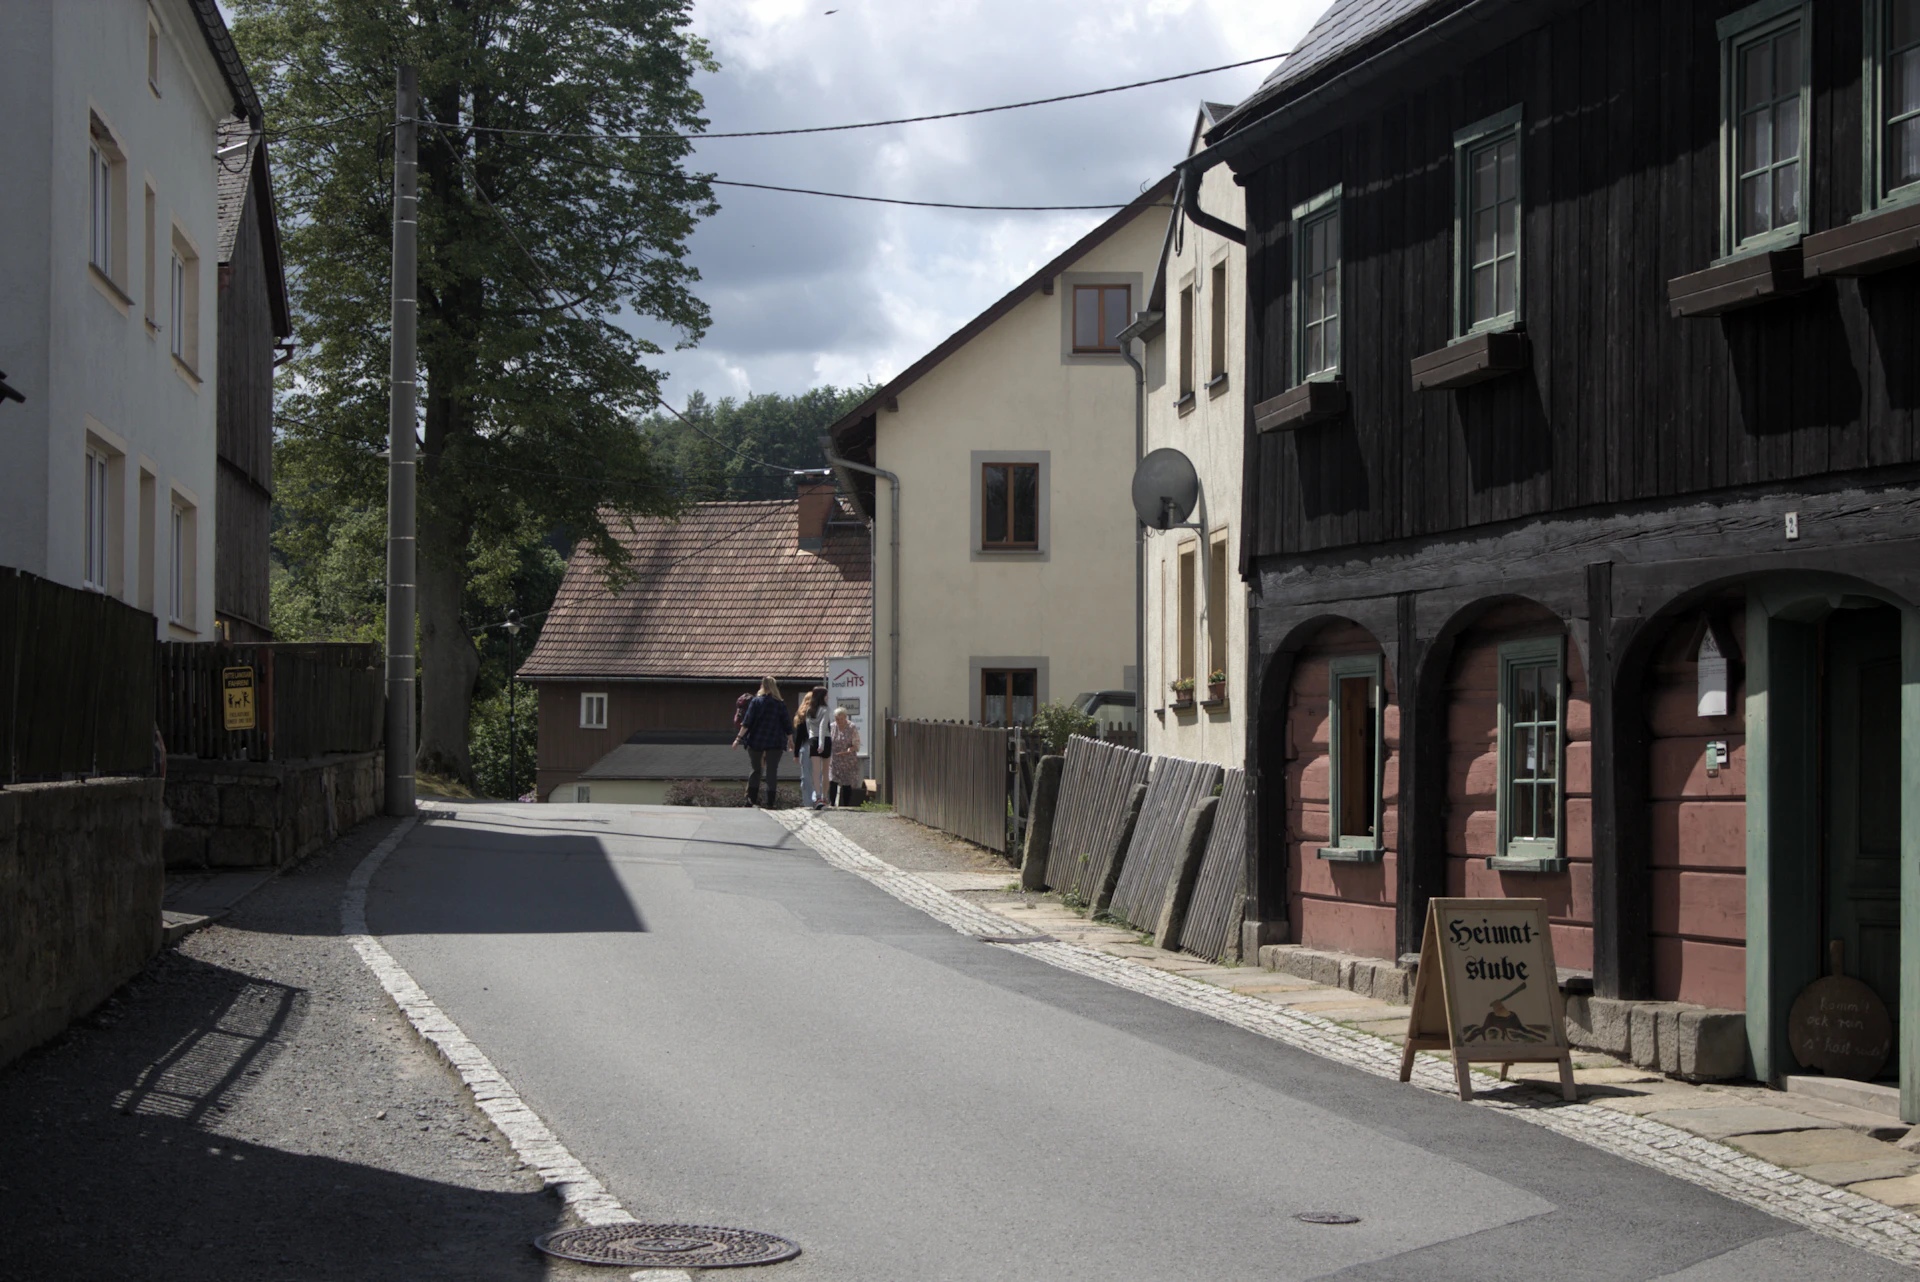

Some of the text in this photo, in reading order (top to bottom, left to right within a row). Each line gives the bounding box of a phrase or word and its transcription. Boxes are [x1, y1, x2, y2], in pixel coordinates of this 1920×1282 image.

[846, 676, 865, 687] HTS
[1449, 918, 1540, 951] Heimat-
[1465, 956, 1530, 981] stube
